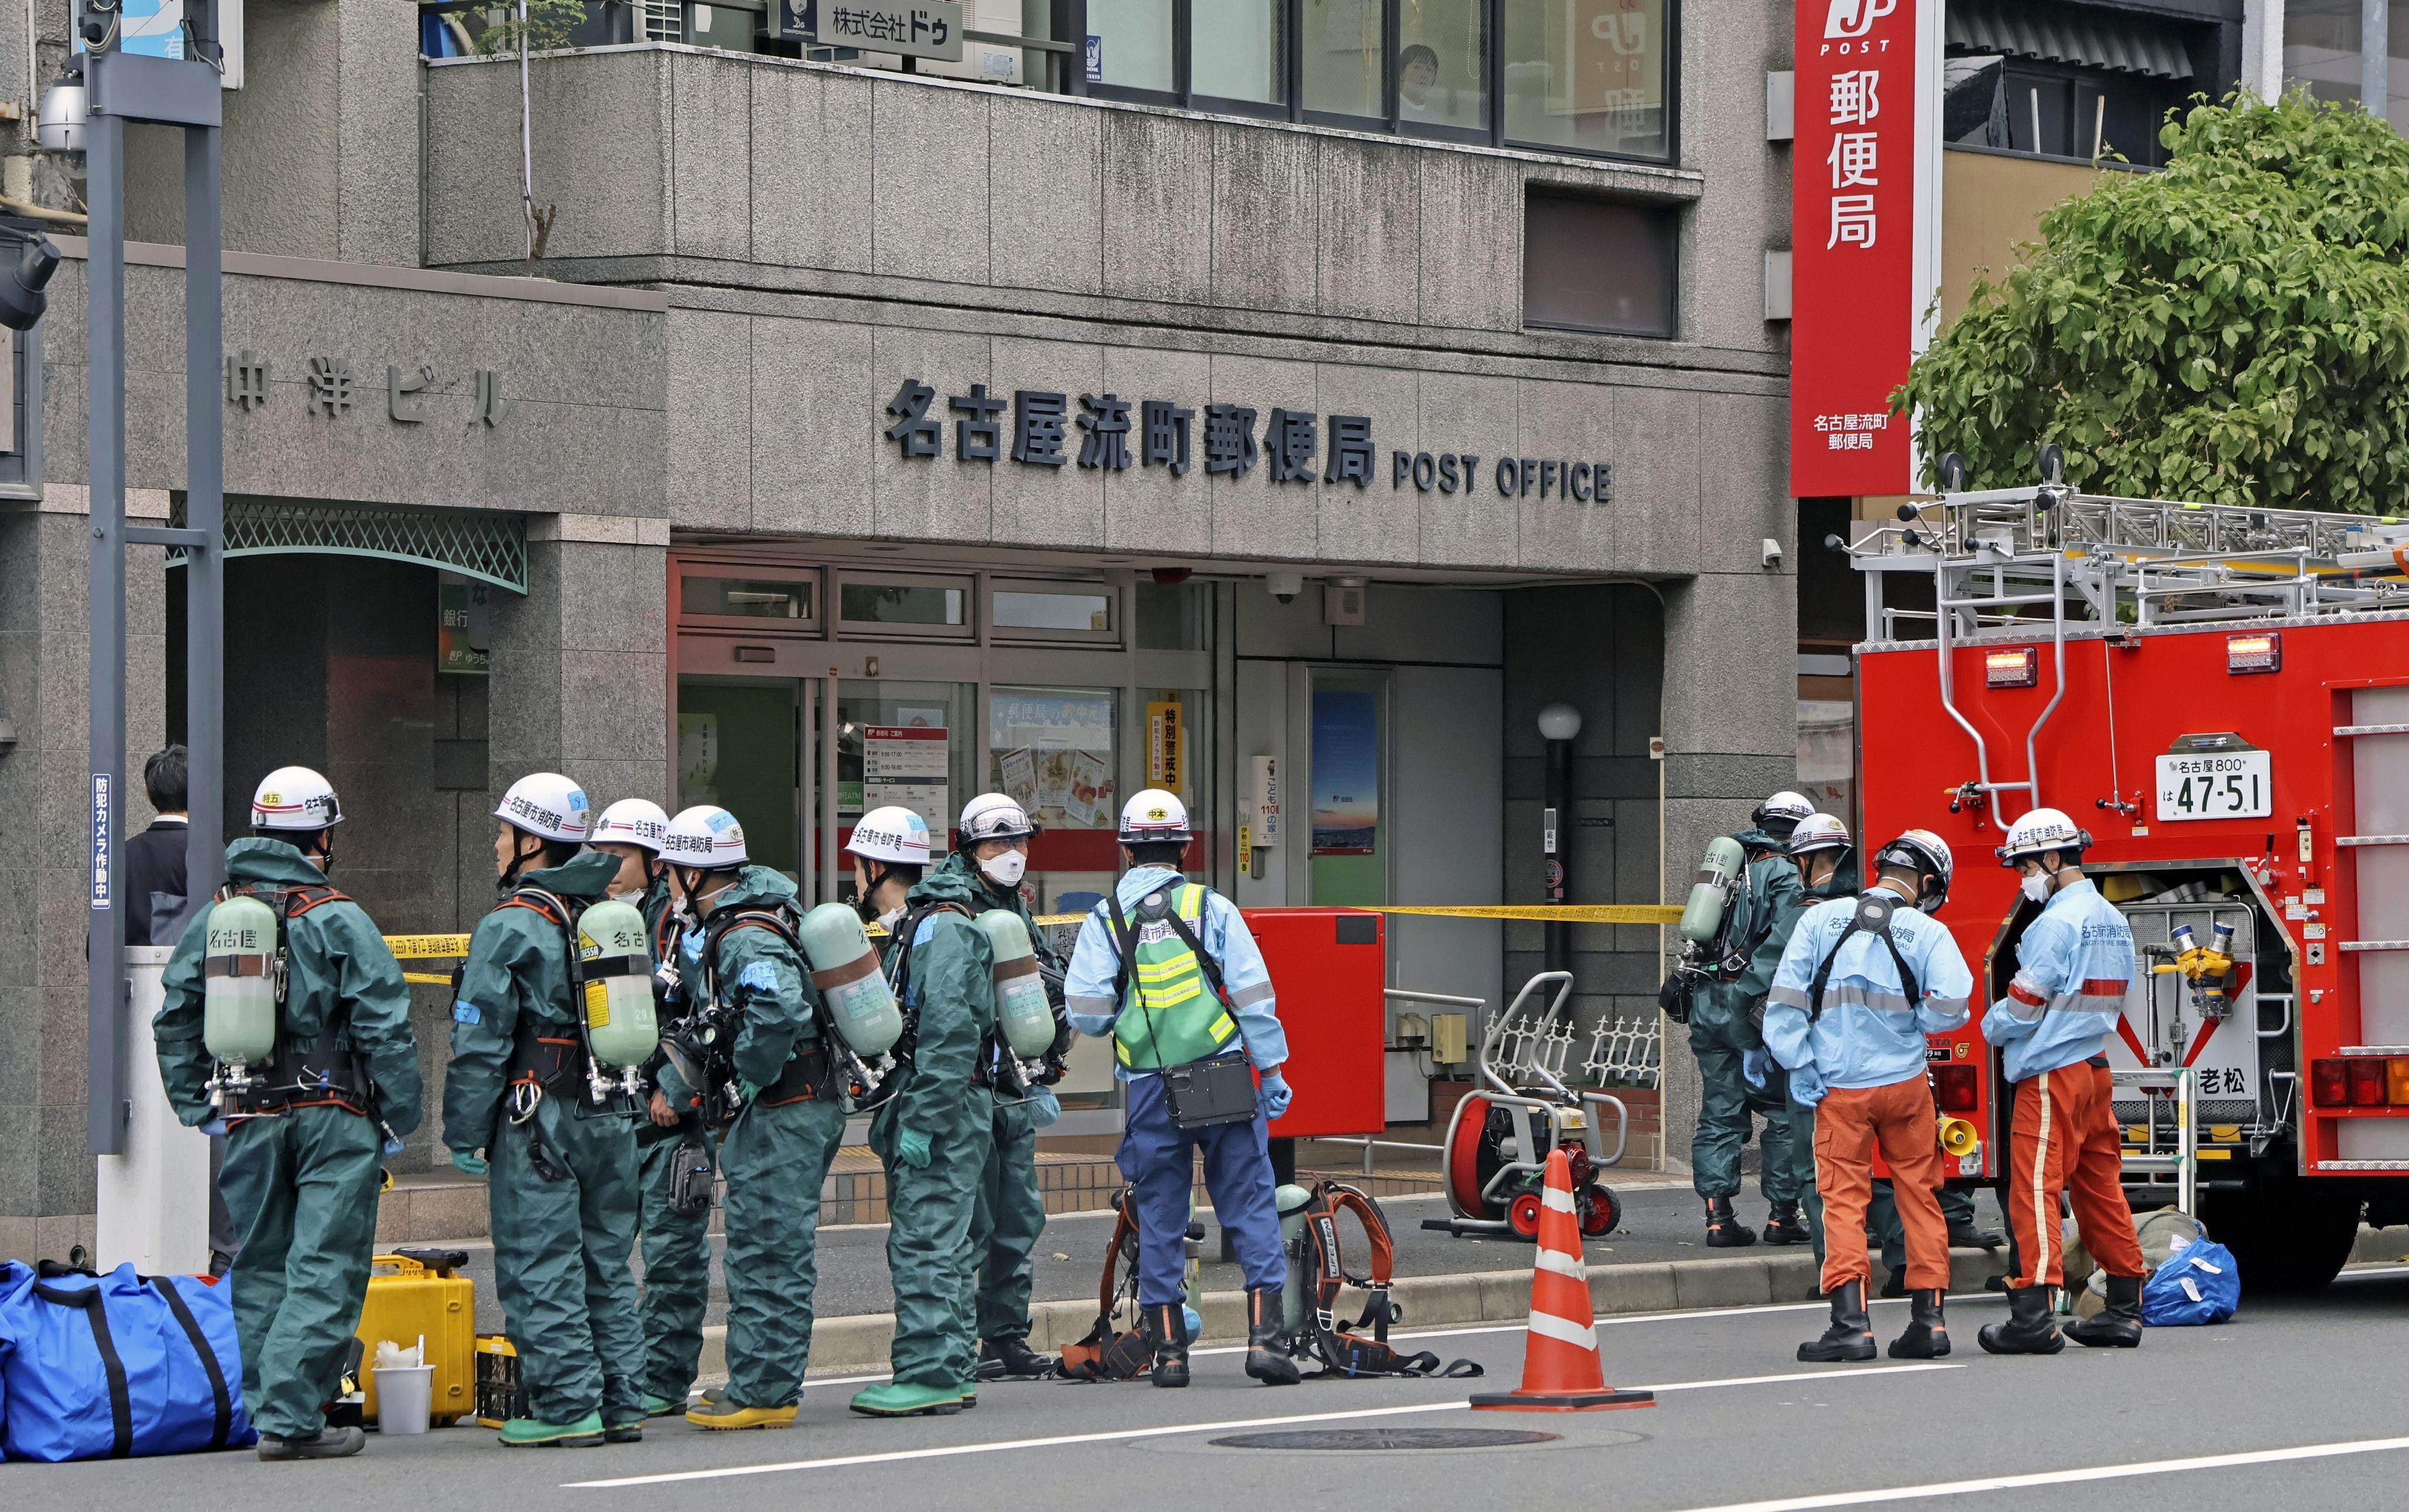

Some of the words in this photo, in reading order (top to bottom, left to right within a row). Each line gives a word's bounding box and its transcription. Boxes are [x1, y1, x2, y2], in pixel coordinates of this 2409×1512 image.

[782, 29, 815, 37] CORPORATION
[1820, 39, 1890, 56] POST
[1827, 70, 1880, 250] 郵便局
[227, 350, 513, 427] 中洋ビル
[1813, 413, 1888, 432] 名古屋流町
[885, 379, 1376, 488] 名古屋流町郵便局
[1393, 450, 1480, 493] POST
[1496, 457, 1612, 502] OFFICE
[1828, 433, 1873, 450] 郵便局
[1165, 708, 1176, 787] 特別警戒中
[2179, 759, 2214, 773] 名古屋
[2216, 758, 2242, 771] 800
[2163, 790, 2174, 802] は
[2178, 774, 2259, 813] 47-51
[509, 795, 563, 832] 名古屋市消防局
[1148, 810, 1166, 819] 中本
[95, 778, 108, 898] 防犯カメラ作動中
[665, 835, 713, 853] 名古屋市消防局
[855, 827, 903, 852] 名古屋市消防局
[209, 929, 257, 948] 名古屋
[2199, 1067, 2245, 1094] 老松
